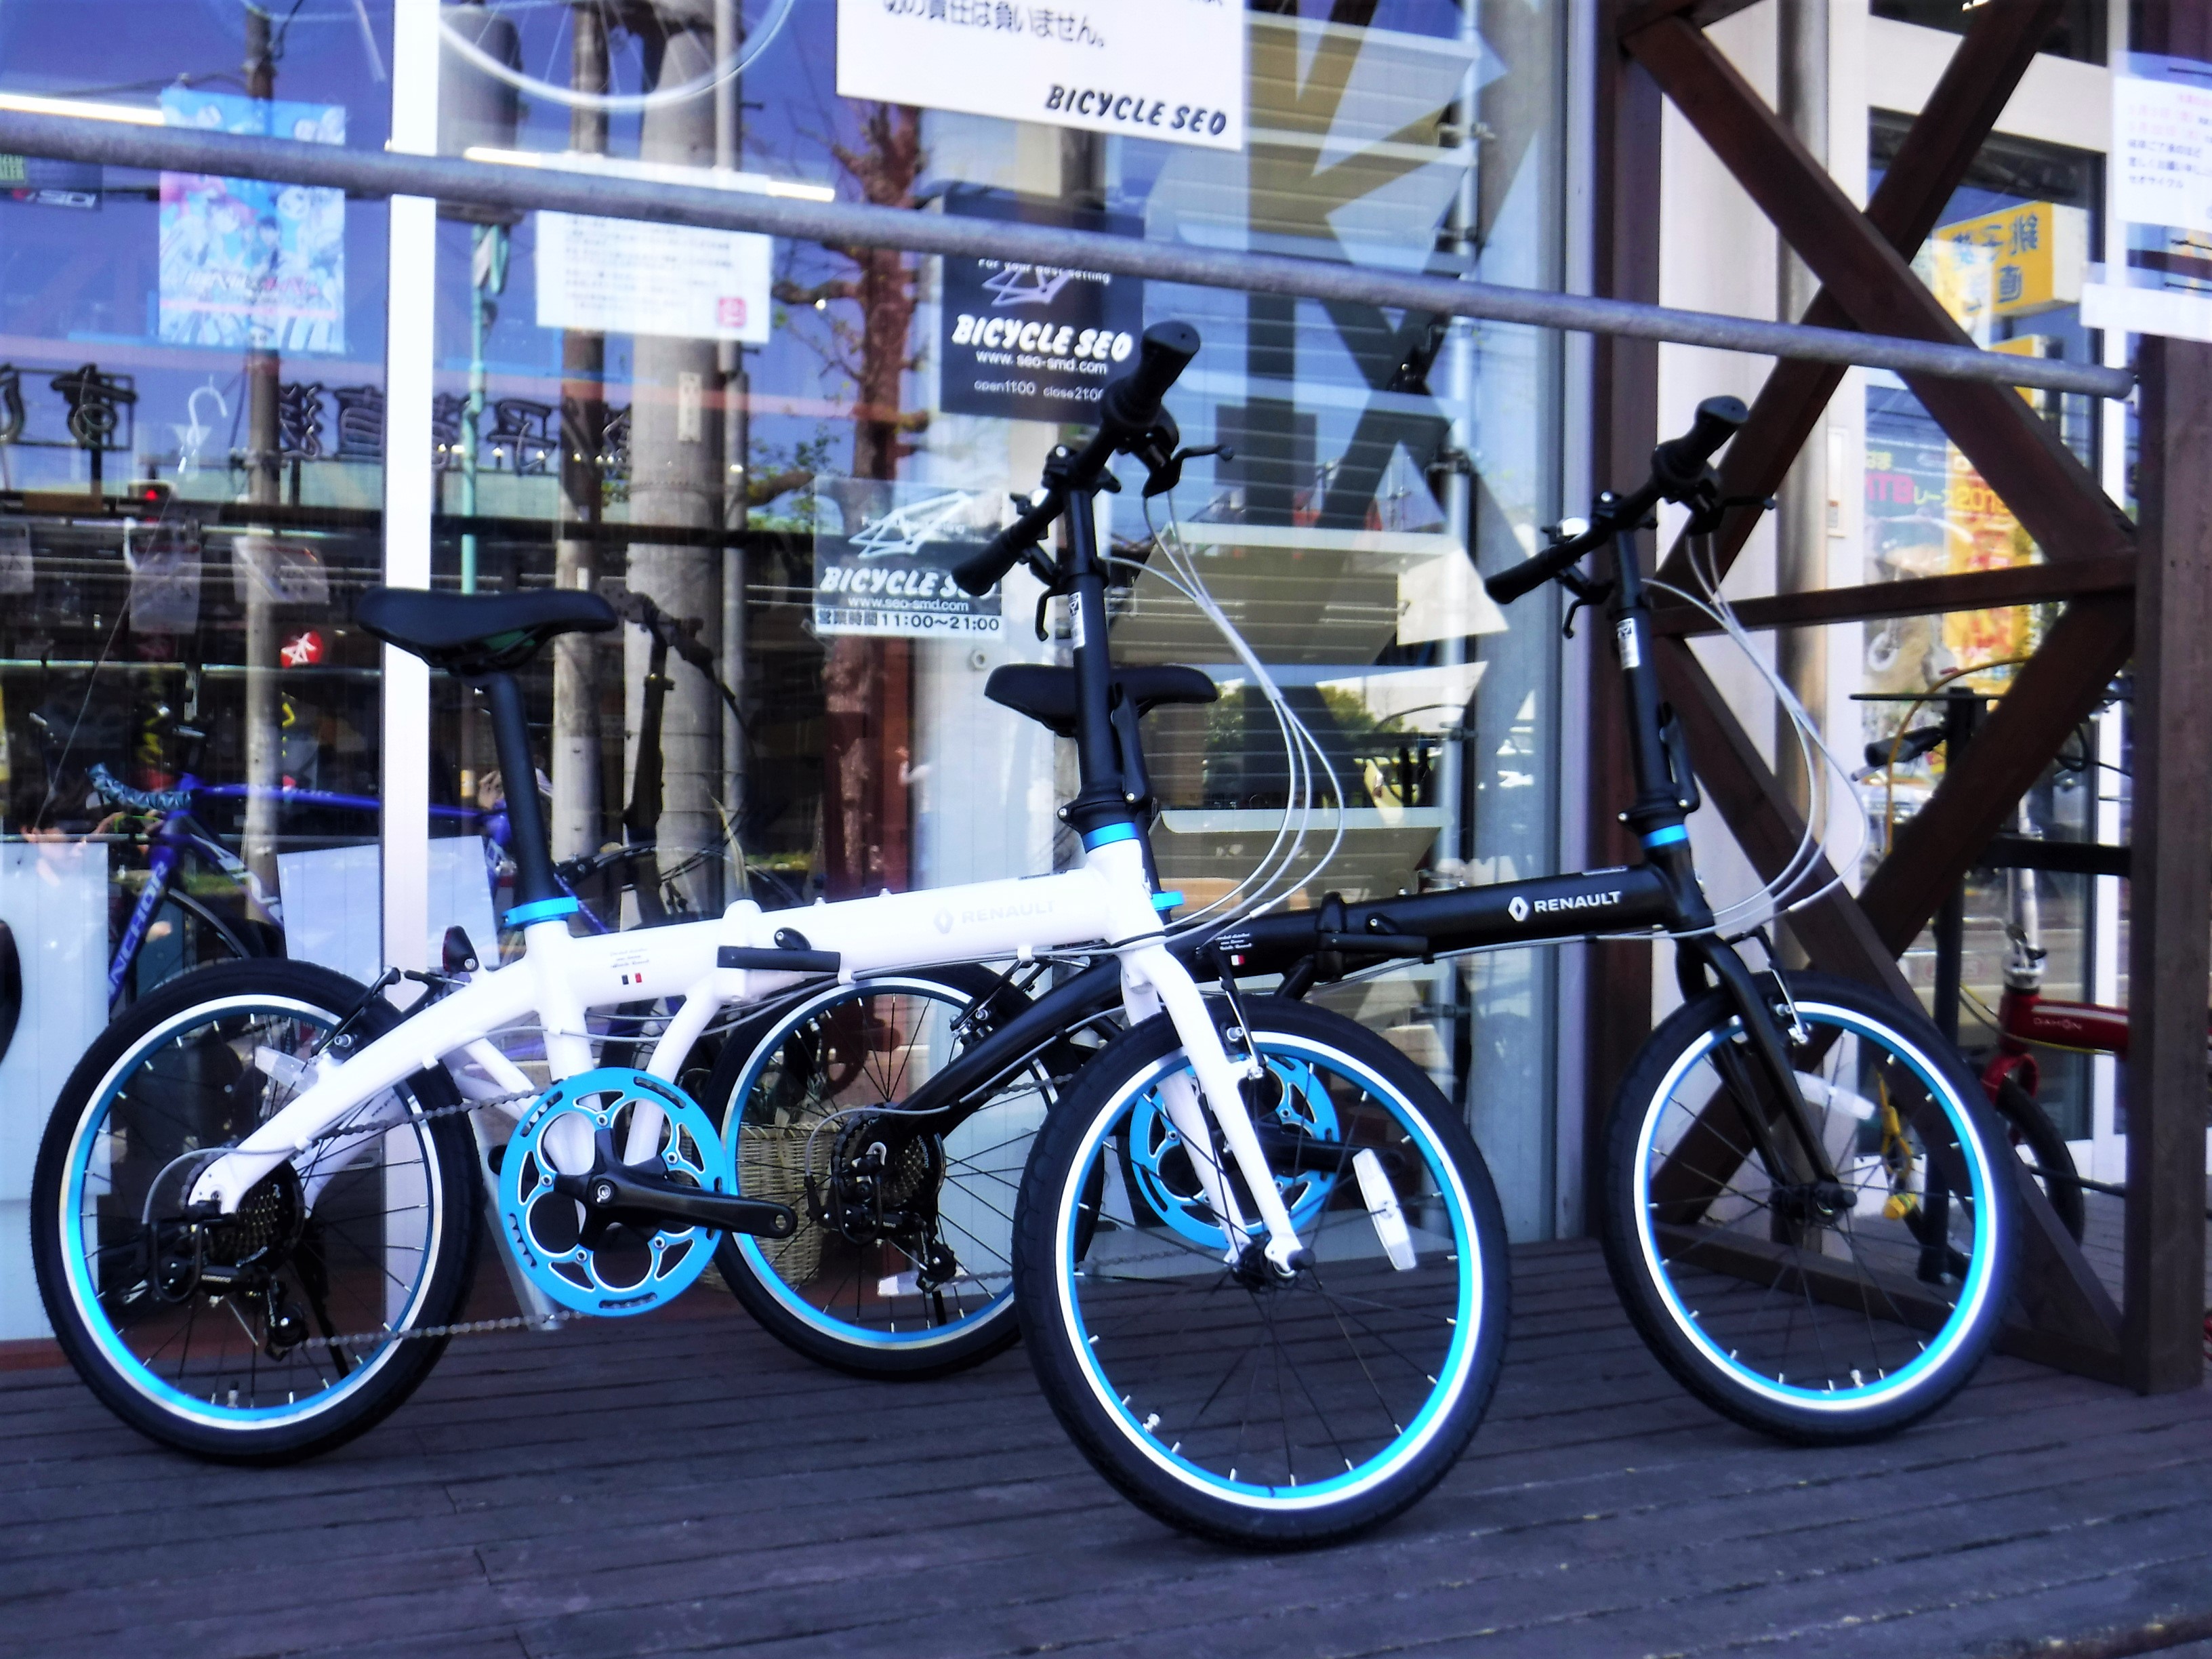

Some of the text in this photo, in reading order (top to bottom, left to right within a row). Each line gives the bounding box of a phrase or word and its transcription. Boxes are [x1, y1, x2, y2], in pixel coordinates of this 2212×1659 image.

[1046, 85, 1227, 136] BICYCLE SEO
[951, 314, 1133, 363] BICYCLE SEO
[819, 566, 939, 597] BICYCLE
[962, 900, 1056, 924] RENAULT
[1534, 890, 1621, 913] RENAULT
